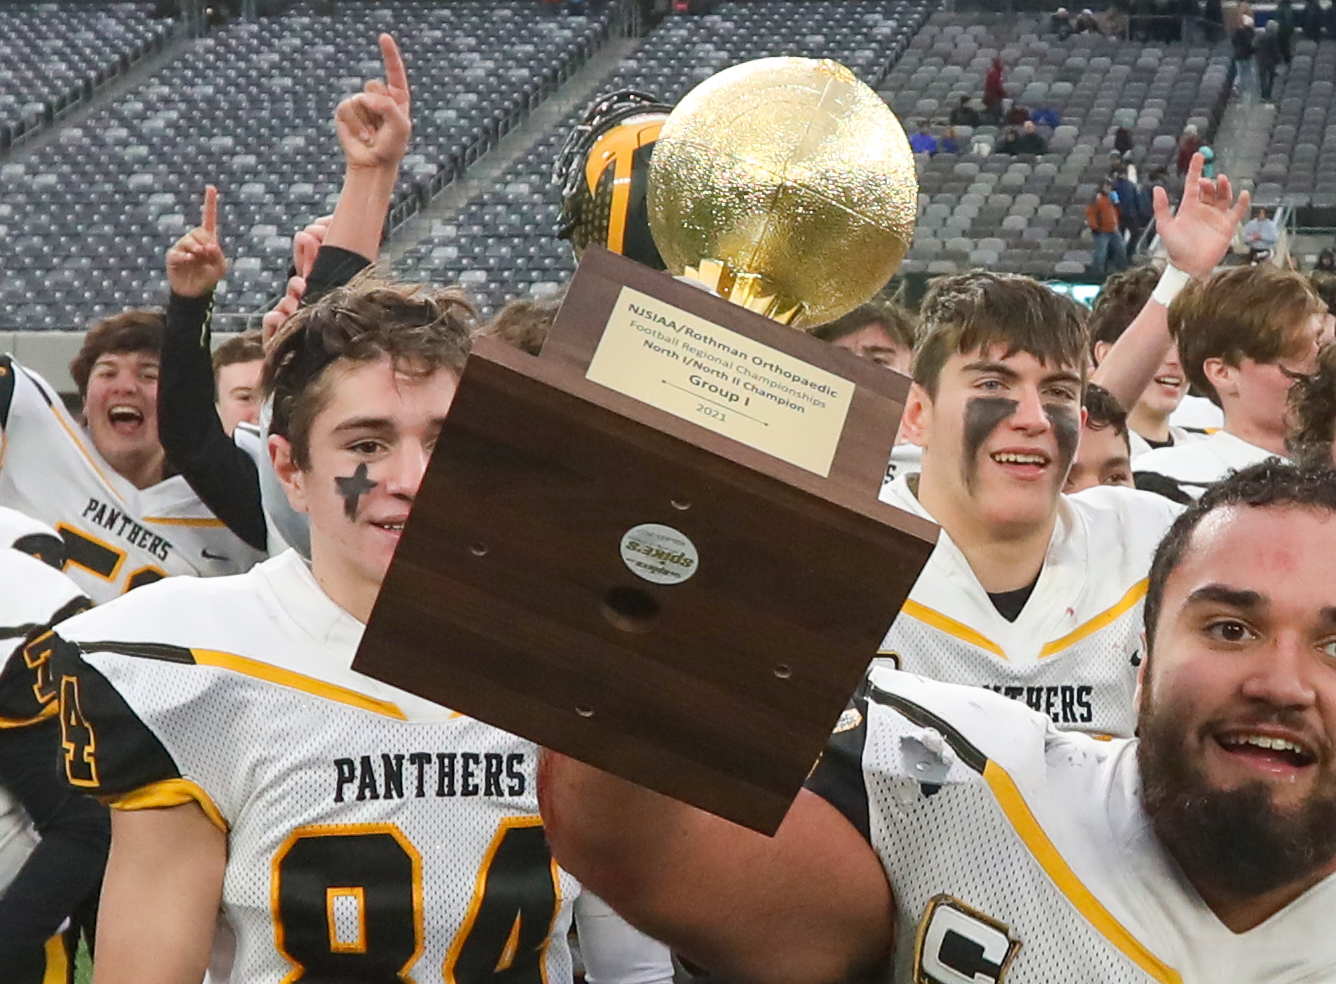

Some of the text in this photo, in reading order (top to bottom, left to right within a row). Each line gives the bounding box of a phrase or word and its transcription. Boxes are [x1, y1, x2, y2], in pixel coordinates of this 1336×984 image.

[628, 303, 838, 399] NJSIAA/Rothman Orthopaedic
[629, 320, 826, 409] Football Regional Championships
[643, 340, 680, 361] North
[682, 356, 729, 382] I/North
[743, 381, 805, 414] Champion
[689, 374, 740, 404] Group
[696, 403, 727, 423] 2021
[82, 498, 174, 562] PANTHERS
[334, 752, 526, 802] PANTHERS
